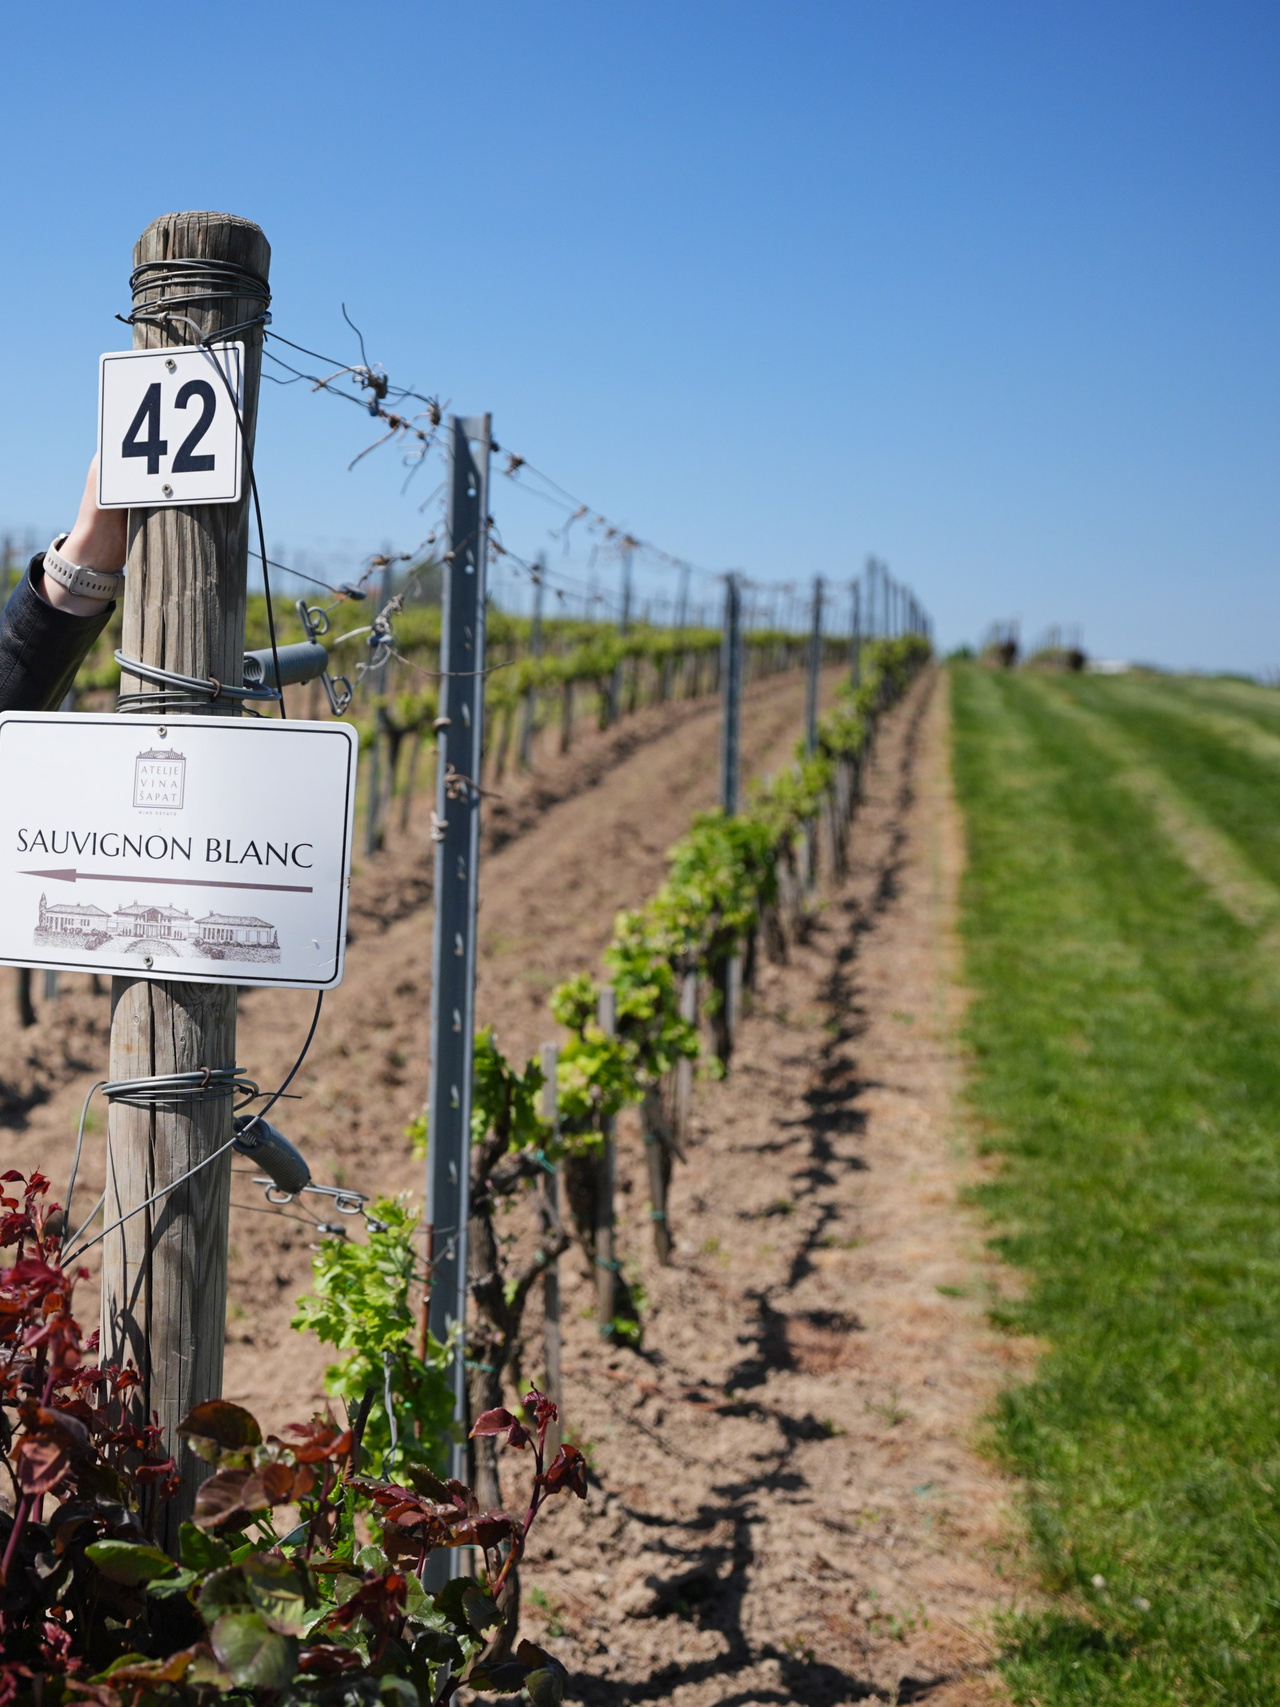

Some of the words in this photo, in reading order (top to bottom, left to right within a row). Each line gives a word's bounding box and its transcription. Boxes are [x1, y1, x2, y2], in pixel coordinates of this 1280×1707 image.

[121, 379, 217, 475] 42
[140, 765, 179, 776] ATELJE
[140, 779, 178, 788] VINA
[139, 790, 177, 802] ŠAPAT
[16, 828, 192, 861] SAUVIGNON
[205, 837, 314, 869] BLANC
